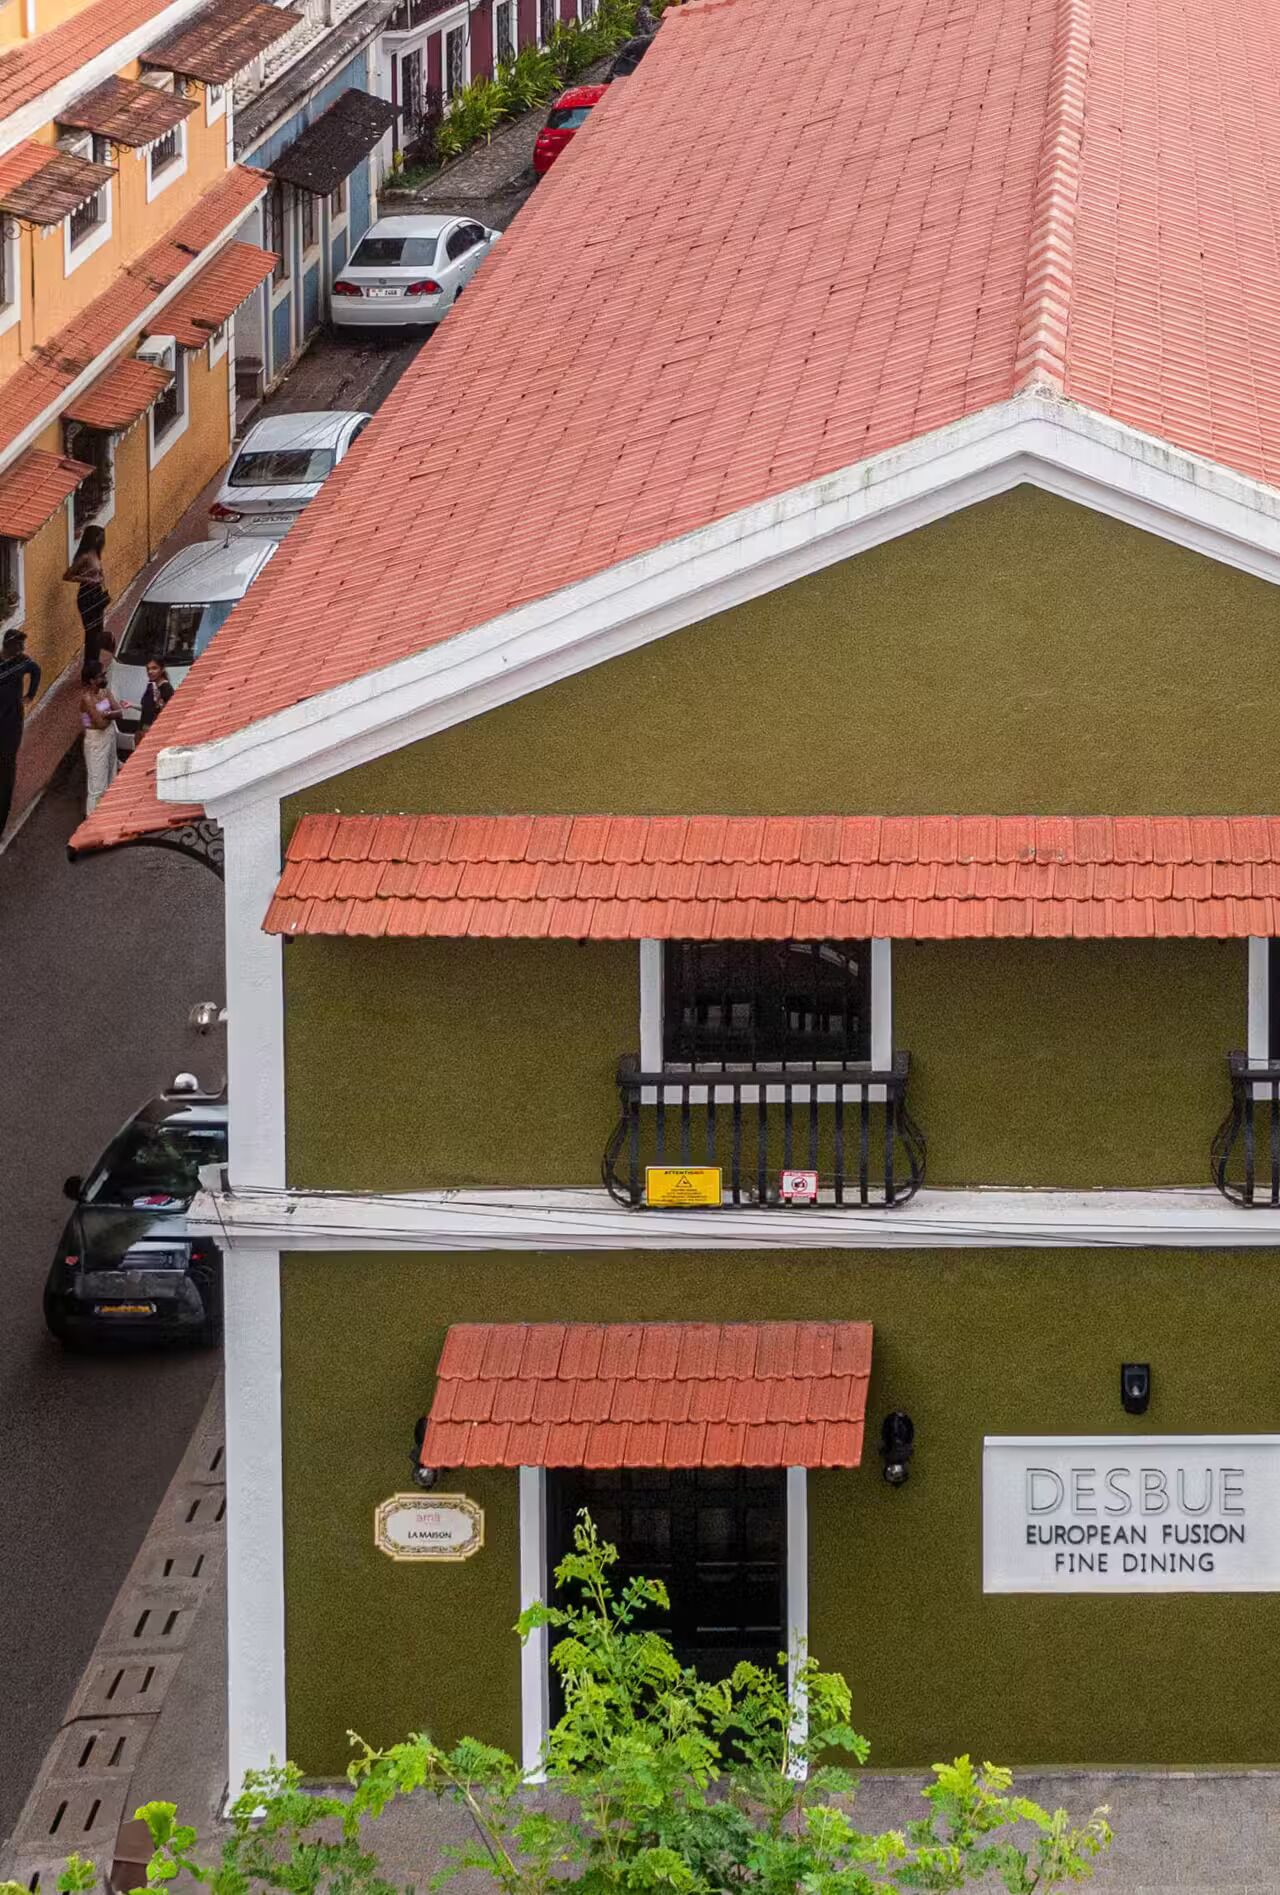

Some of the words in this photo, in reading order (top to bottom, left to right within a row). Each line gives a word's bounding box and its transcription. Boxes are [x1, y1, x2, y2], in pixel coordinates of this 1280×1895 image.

[1025, 1467, 1246, 1516] DESBUE
[407, 1531, 418, 1539] LA
[419, 1531, 452, 1539] MAISON
[1026, 1524, 1147, 1545] EUROPEAN
[1162, 1523, 1246, 1545] FUSION
[1055, 1552, 1108, 1573] FINE
[1122, 1552, 1214, 1573] DINING
